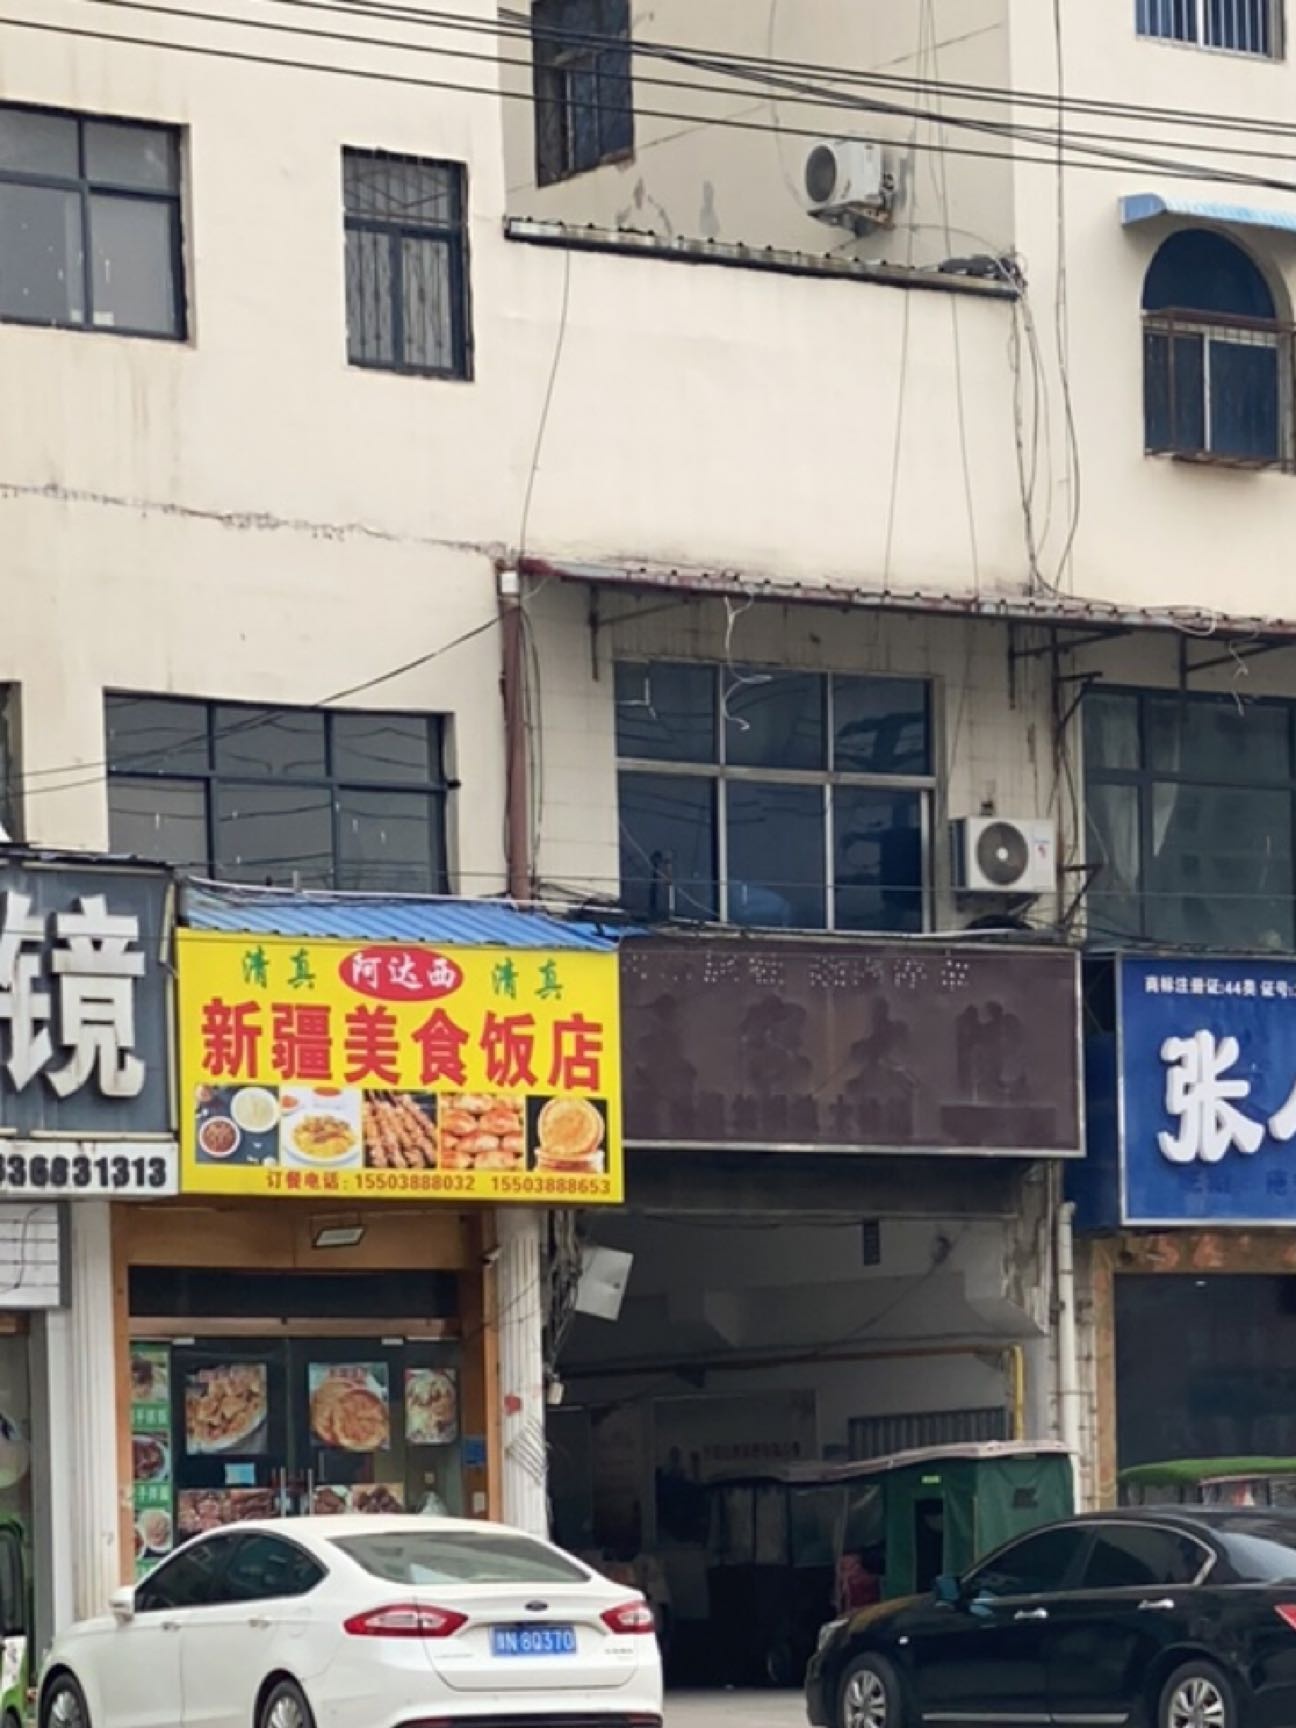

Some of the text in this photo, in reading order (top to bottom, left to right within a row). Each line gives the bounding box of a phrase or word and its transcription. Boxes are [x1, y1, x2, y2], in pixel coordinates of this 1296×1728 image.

[241, 948, 317, 990] 清真
[350, 956, 460, 990] 阿达西
[490, 962, 564, 1001] 清真
[0, 895, 146, 1097] 镜
[200, 998, 604, 1091] 新疆美食饭店
[490, 1177, 612, 1195] 15503888653
